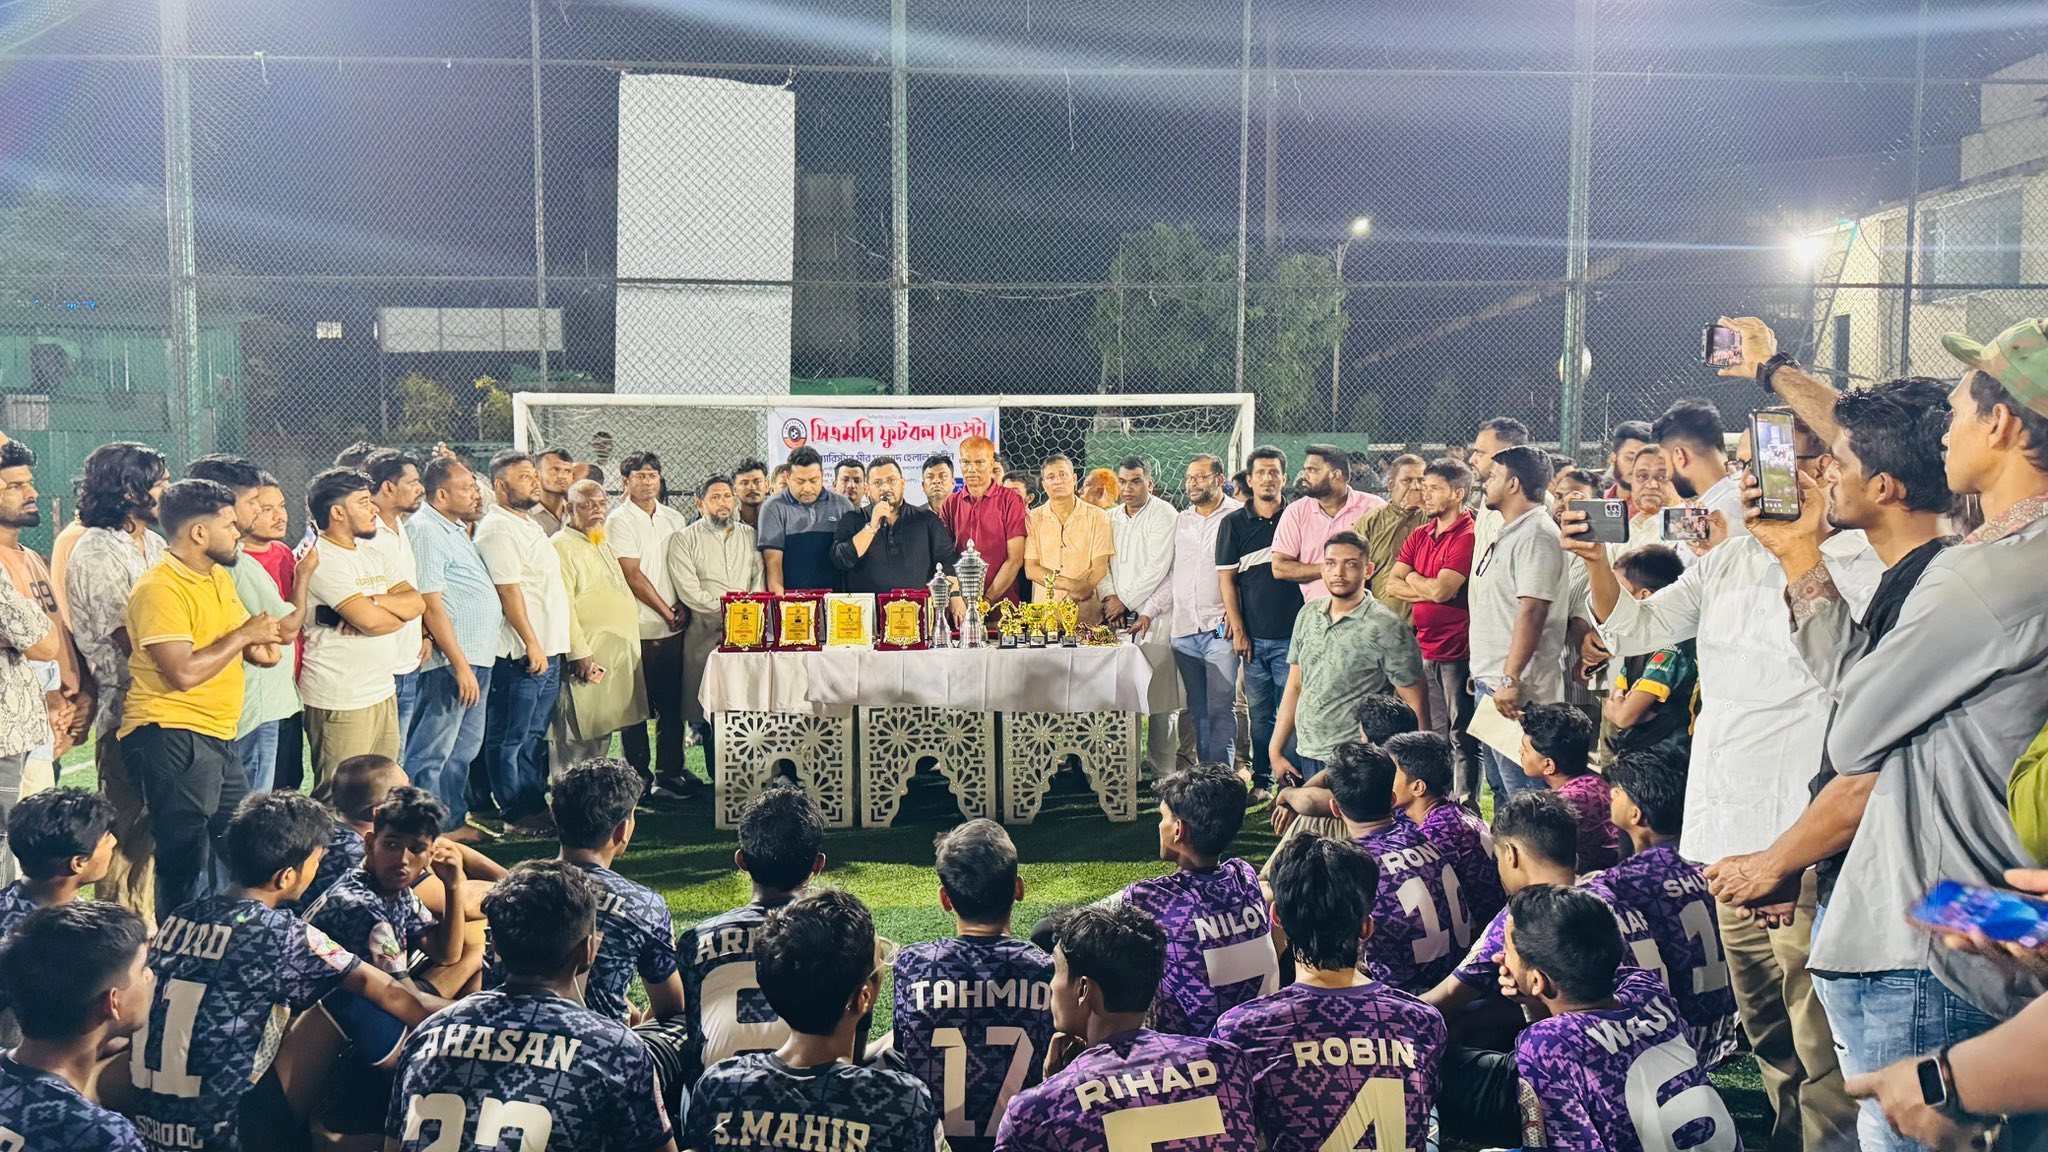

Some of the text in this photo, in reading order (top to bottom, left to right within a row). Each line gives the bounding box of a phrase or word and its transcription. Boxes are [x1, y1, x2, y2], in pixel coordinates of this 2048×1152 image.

[810, 417, 875, 443] সিএমপি
[879, 421, 935, 448] ফুটবল
[903, 453, 929, 463] হেলাল
[1194, 901, 1269, 942] NILOY
[1396, 863, 1472, 965] 10
[910, 979, 1051, 1011] TAHMID
[415, 1023, 582, 1073] AHASAN
[1293, 1037, 1417, 1070] ROBIN
[930, 1026, 1035, 1138] 17
[1074, 1059, 1218, 1112] RIHAD
[1625, 1032, 1738, 1152] 6
[135, 1114, 204, 1150] SCHOOL
[709, 1110, 872, 1152] S.MAHIR
